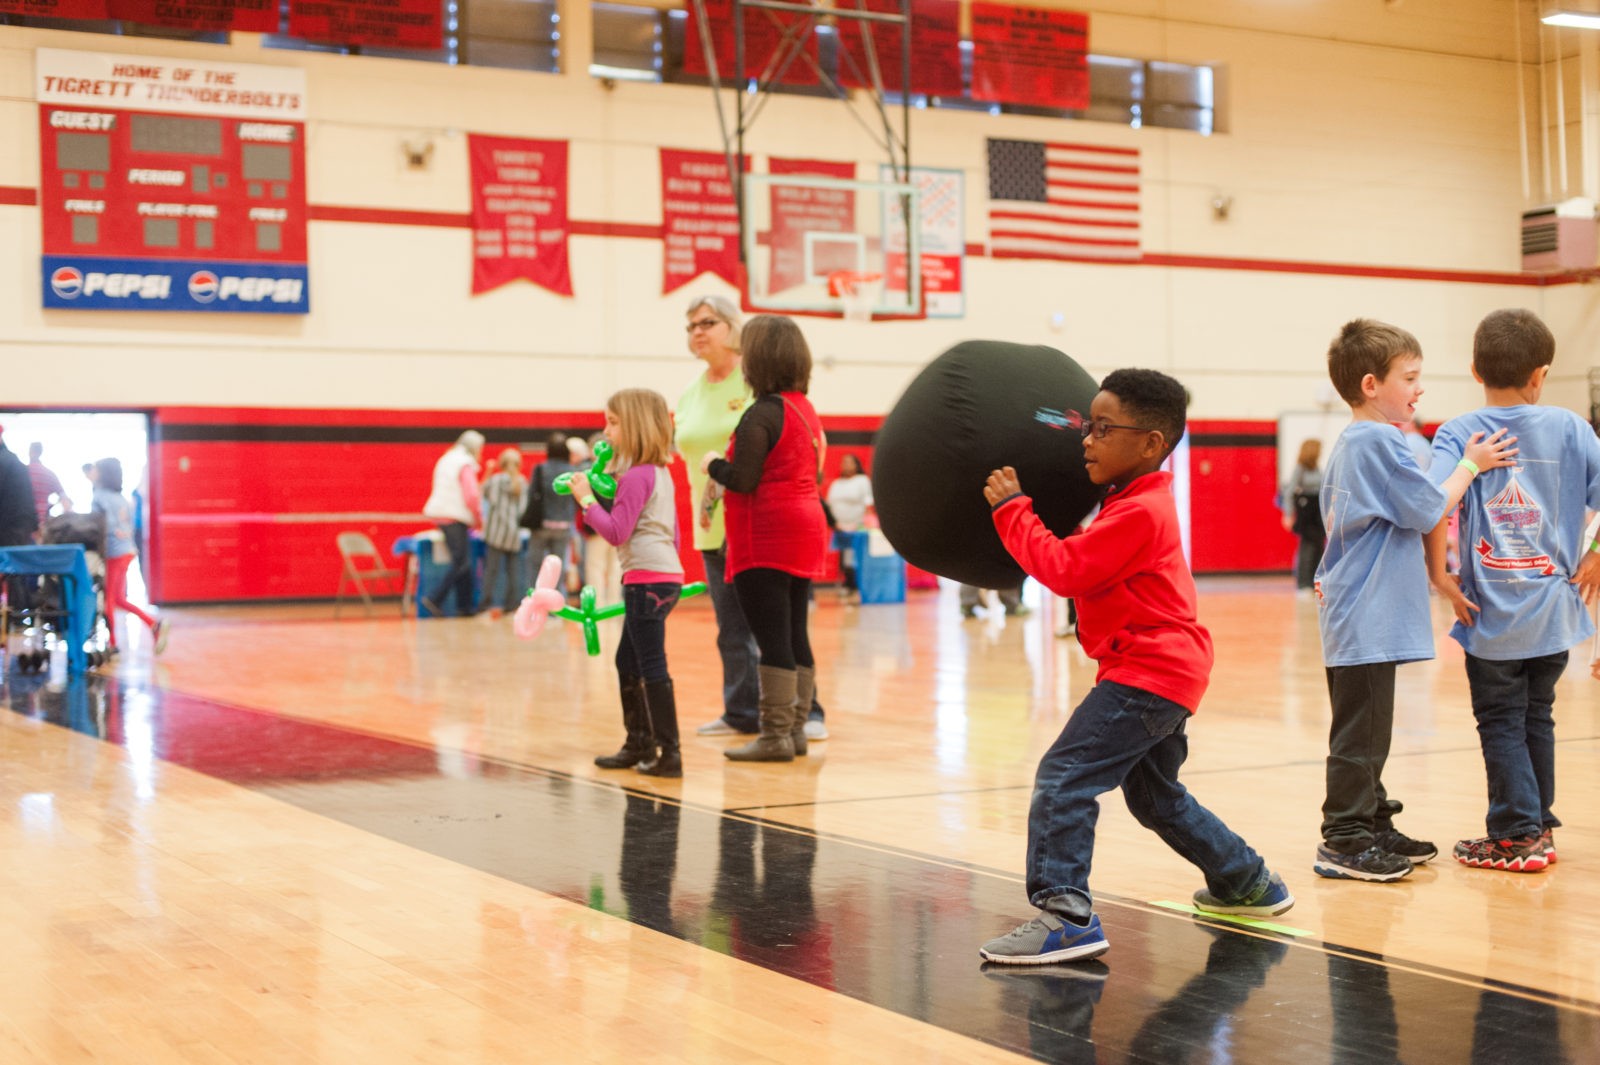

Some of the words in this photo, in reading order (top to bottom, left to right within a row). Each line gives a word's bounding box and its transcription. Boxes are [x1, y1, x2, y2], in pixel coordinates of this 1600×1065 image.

[112, 63, 162, 80] HOME
[172, 68, 195, 82] OF
[204, 70, 237, 85] THE
[44, 75, 135, 98] TIGRETT
[146, 83, 302, 110] THUNDERBOLTS
[50, 109, 116, 131] GUEST
[237, 122, 295, 142] HOME
[127, 168, 186, 187] PERIOD
[82, 271, 172, 300] PEPSI
[218, 275, 304, 303] PEPSI
